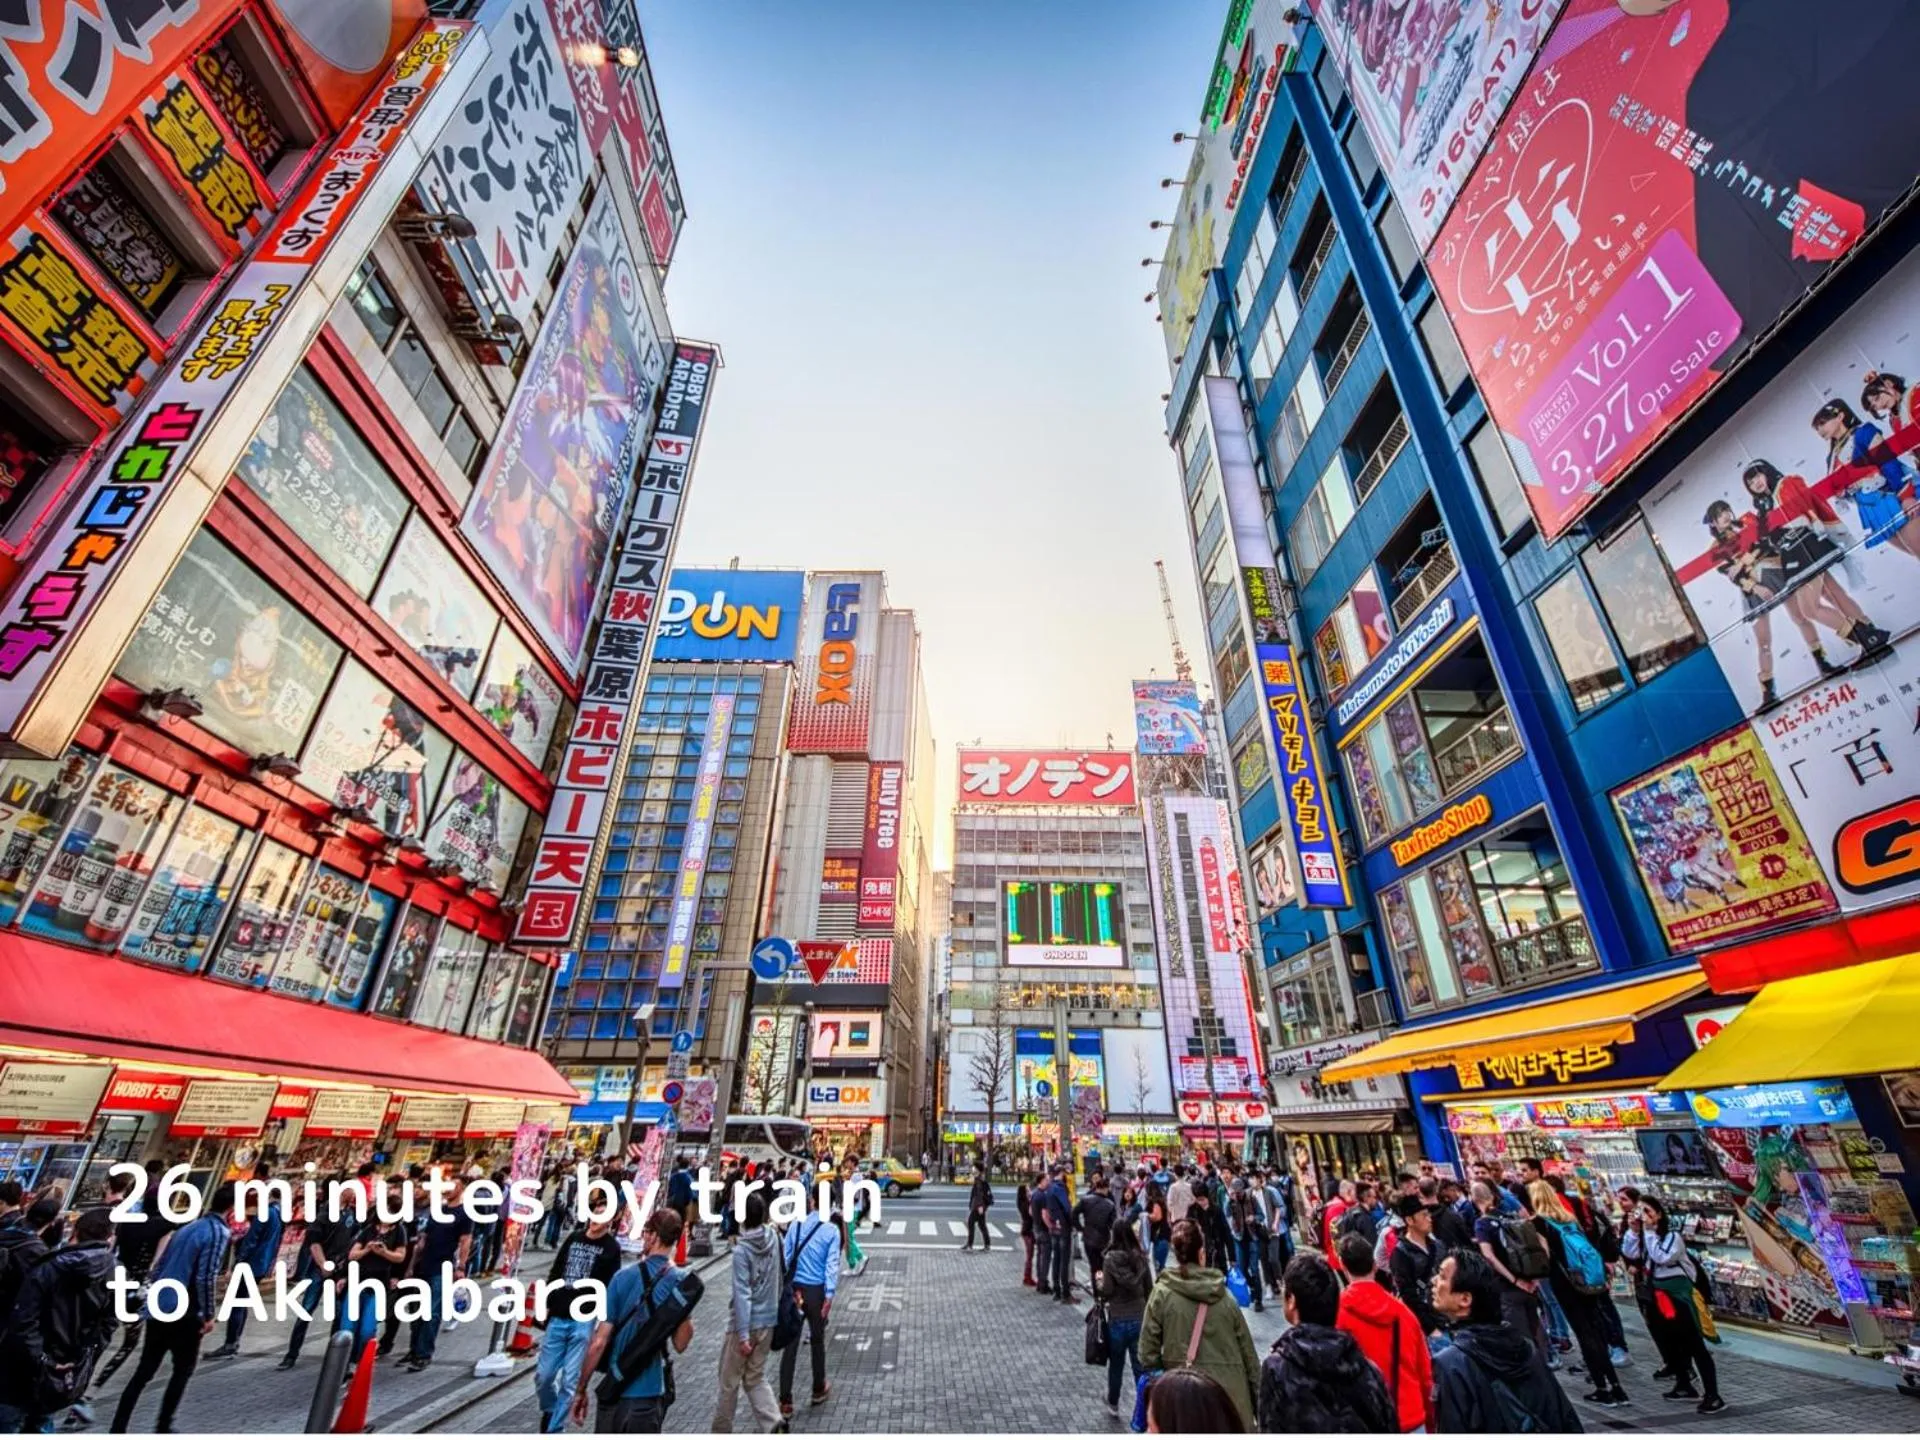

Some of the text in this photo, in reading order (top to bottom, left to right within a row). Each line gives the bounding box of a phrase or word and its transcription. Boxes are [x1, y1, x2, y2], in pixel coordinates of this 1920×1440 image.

[361, 86, 423, 141] 買取り
[1420, 38, 1517, 218] 3.16(SAT)
[590, 196, 663, 378] FIORE
[1511, 212, 1627, 368] らせたい
[1572, 256, 1695, 388] Vol. 1
[180, 298, 247, 383] 買います
[207, 284, 291, 379] フィギュア
[659, 347, 689, 432] PARADISE
[685, 348, 708, 407] HOBBY
[1550, 382, 1639, 495] 3.27
[1638, 386, 1672, 415] On
[1671, 329, 1724, 376] Sale
[0, 402, 204, 681] とれじゃらす
[1266, 662, 1291, 684] 薬
[1339, 657, 1400, 723] Matsumoto
[57, 754, 88, 796] 高
[963, 753, 1130, 797] オノデン
[1270, 696, 1323, 841] マツモト キヨシ
[877, 767, 901, 849] Duty Free
[1392, 795, 1491, 866] Tax Free Shop
[1751, 834, 1778, 849] DVD
[141, 940, 190, 964] いずれも
[806, 951, 835, 961] 止まれ
[1043, 951, 1088, 960] ONODEN
[112, 1081, 183, 1101] HOBBY 天国
